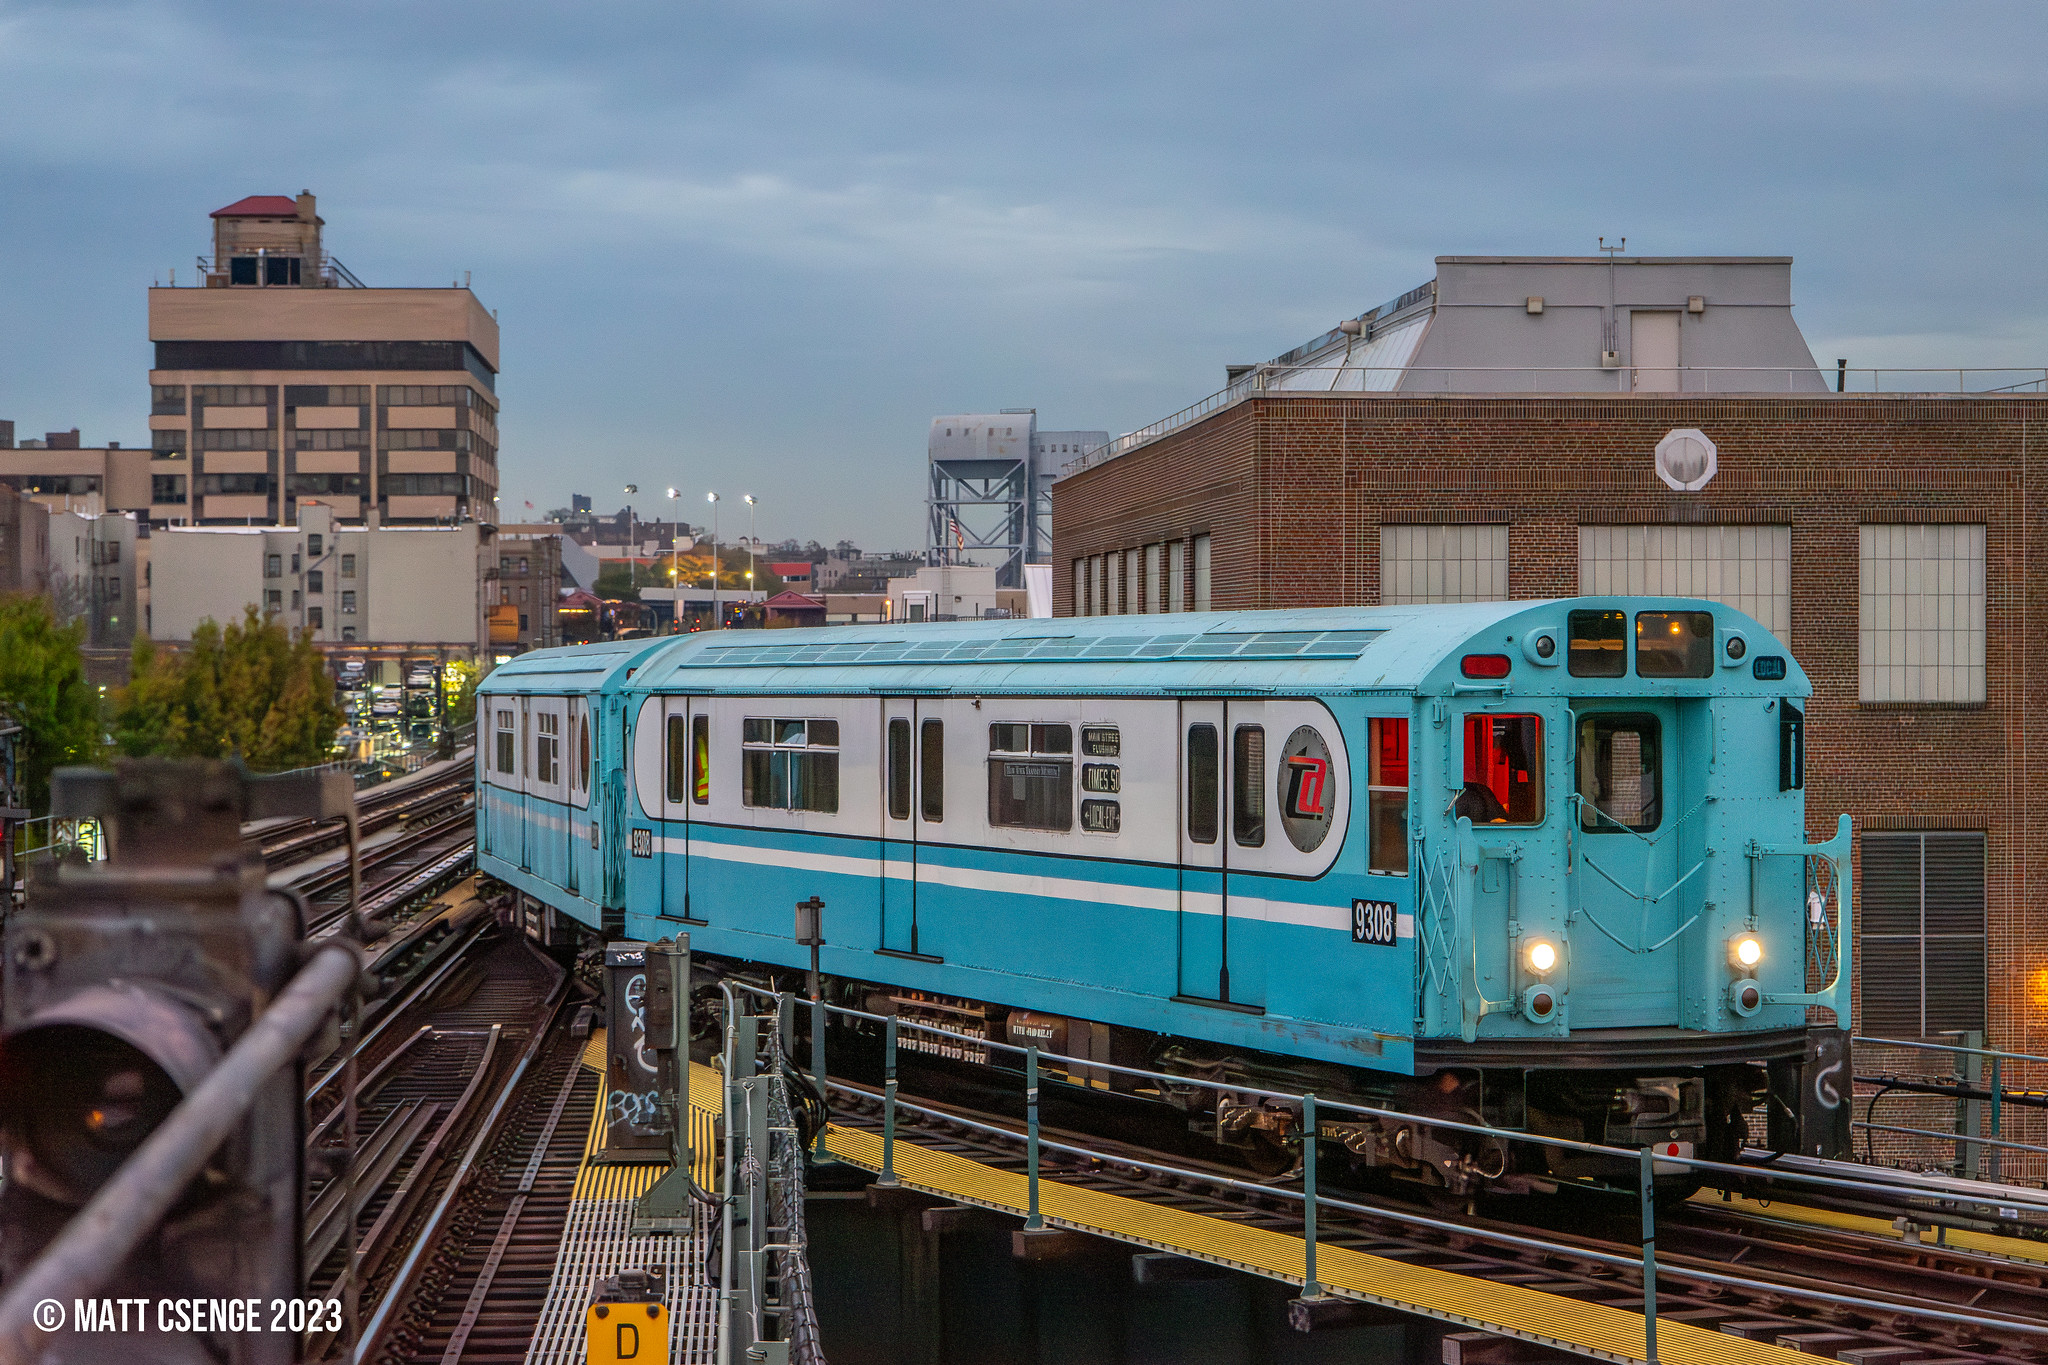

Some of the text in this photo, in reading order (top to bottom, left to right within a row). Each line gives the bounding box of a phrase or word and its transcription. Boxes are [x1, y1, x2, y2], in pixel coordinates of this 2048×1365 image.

[1101, 732, 1120, 743] STREE
[1087, 768, 1109, 790] TIMES
[1355, 901, 1393, 943] 9308
[616, 1323, 640, 1360] D
